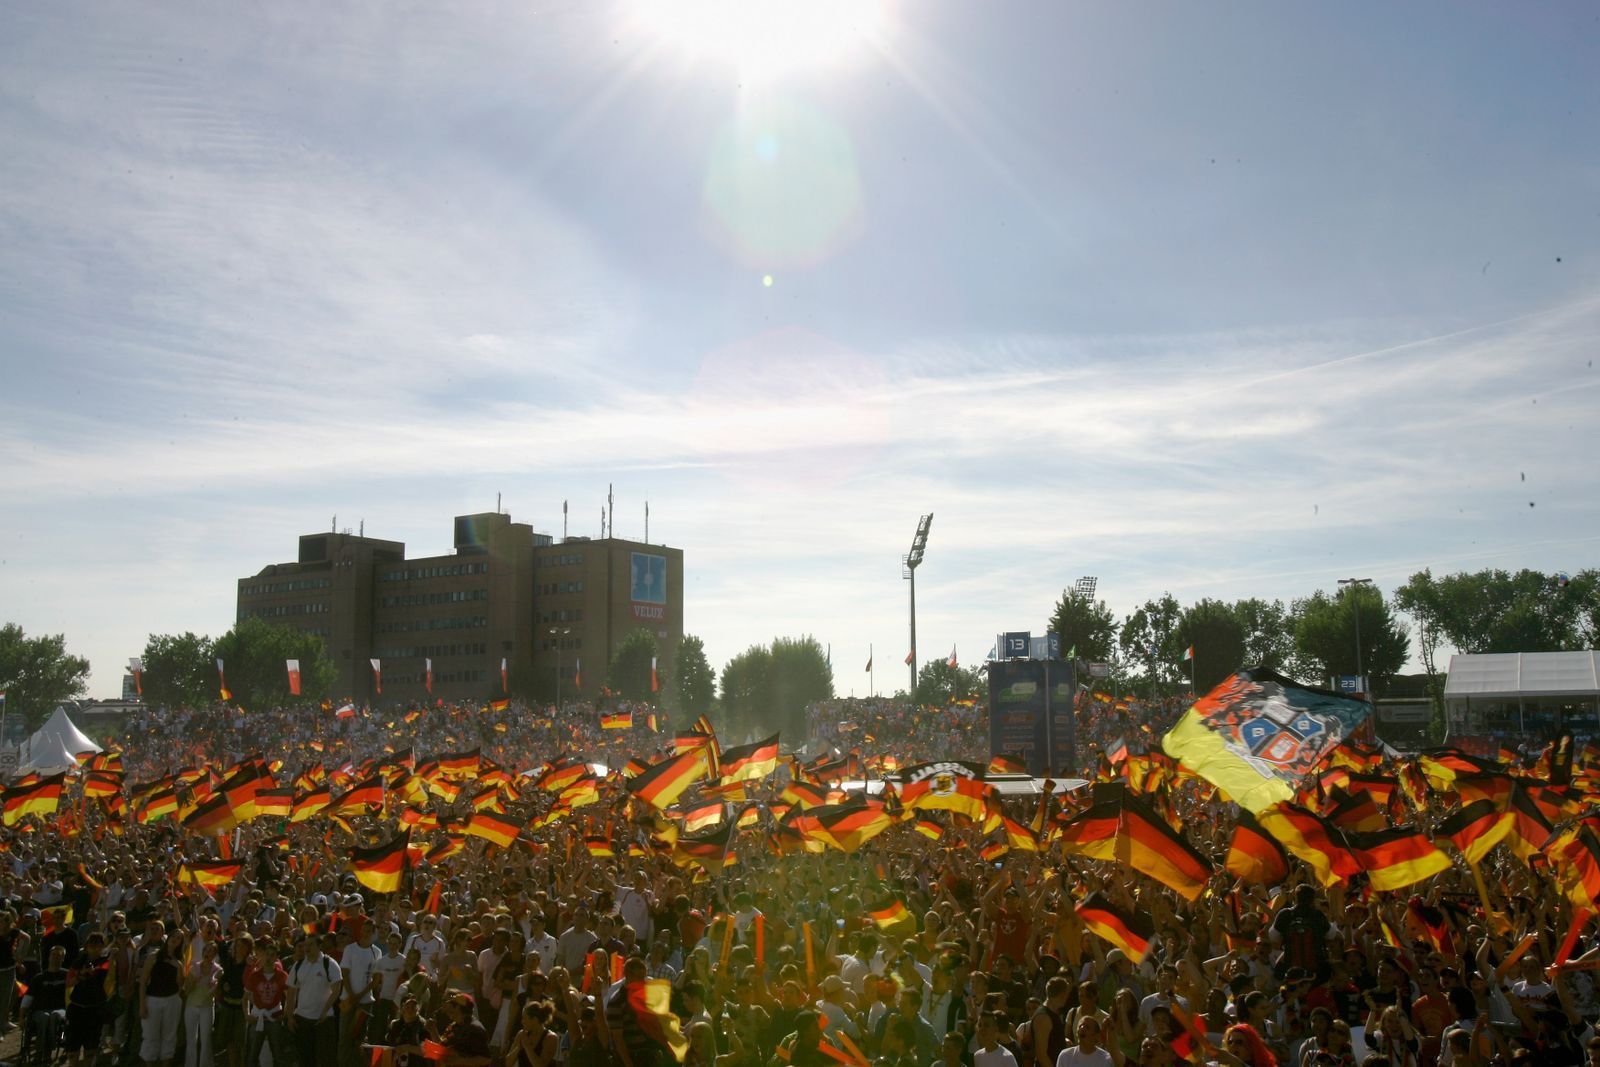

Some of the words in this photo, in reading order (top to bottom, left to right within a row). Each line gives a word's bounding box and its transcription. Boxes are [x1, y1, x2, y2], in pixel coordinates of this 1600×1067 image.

[634, 605, 663, 619] VELUX
[1010, 639, 1025, 650] 13
[1341, 680, 1356, 688] 23
